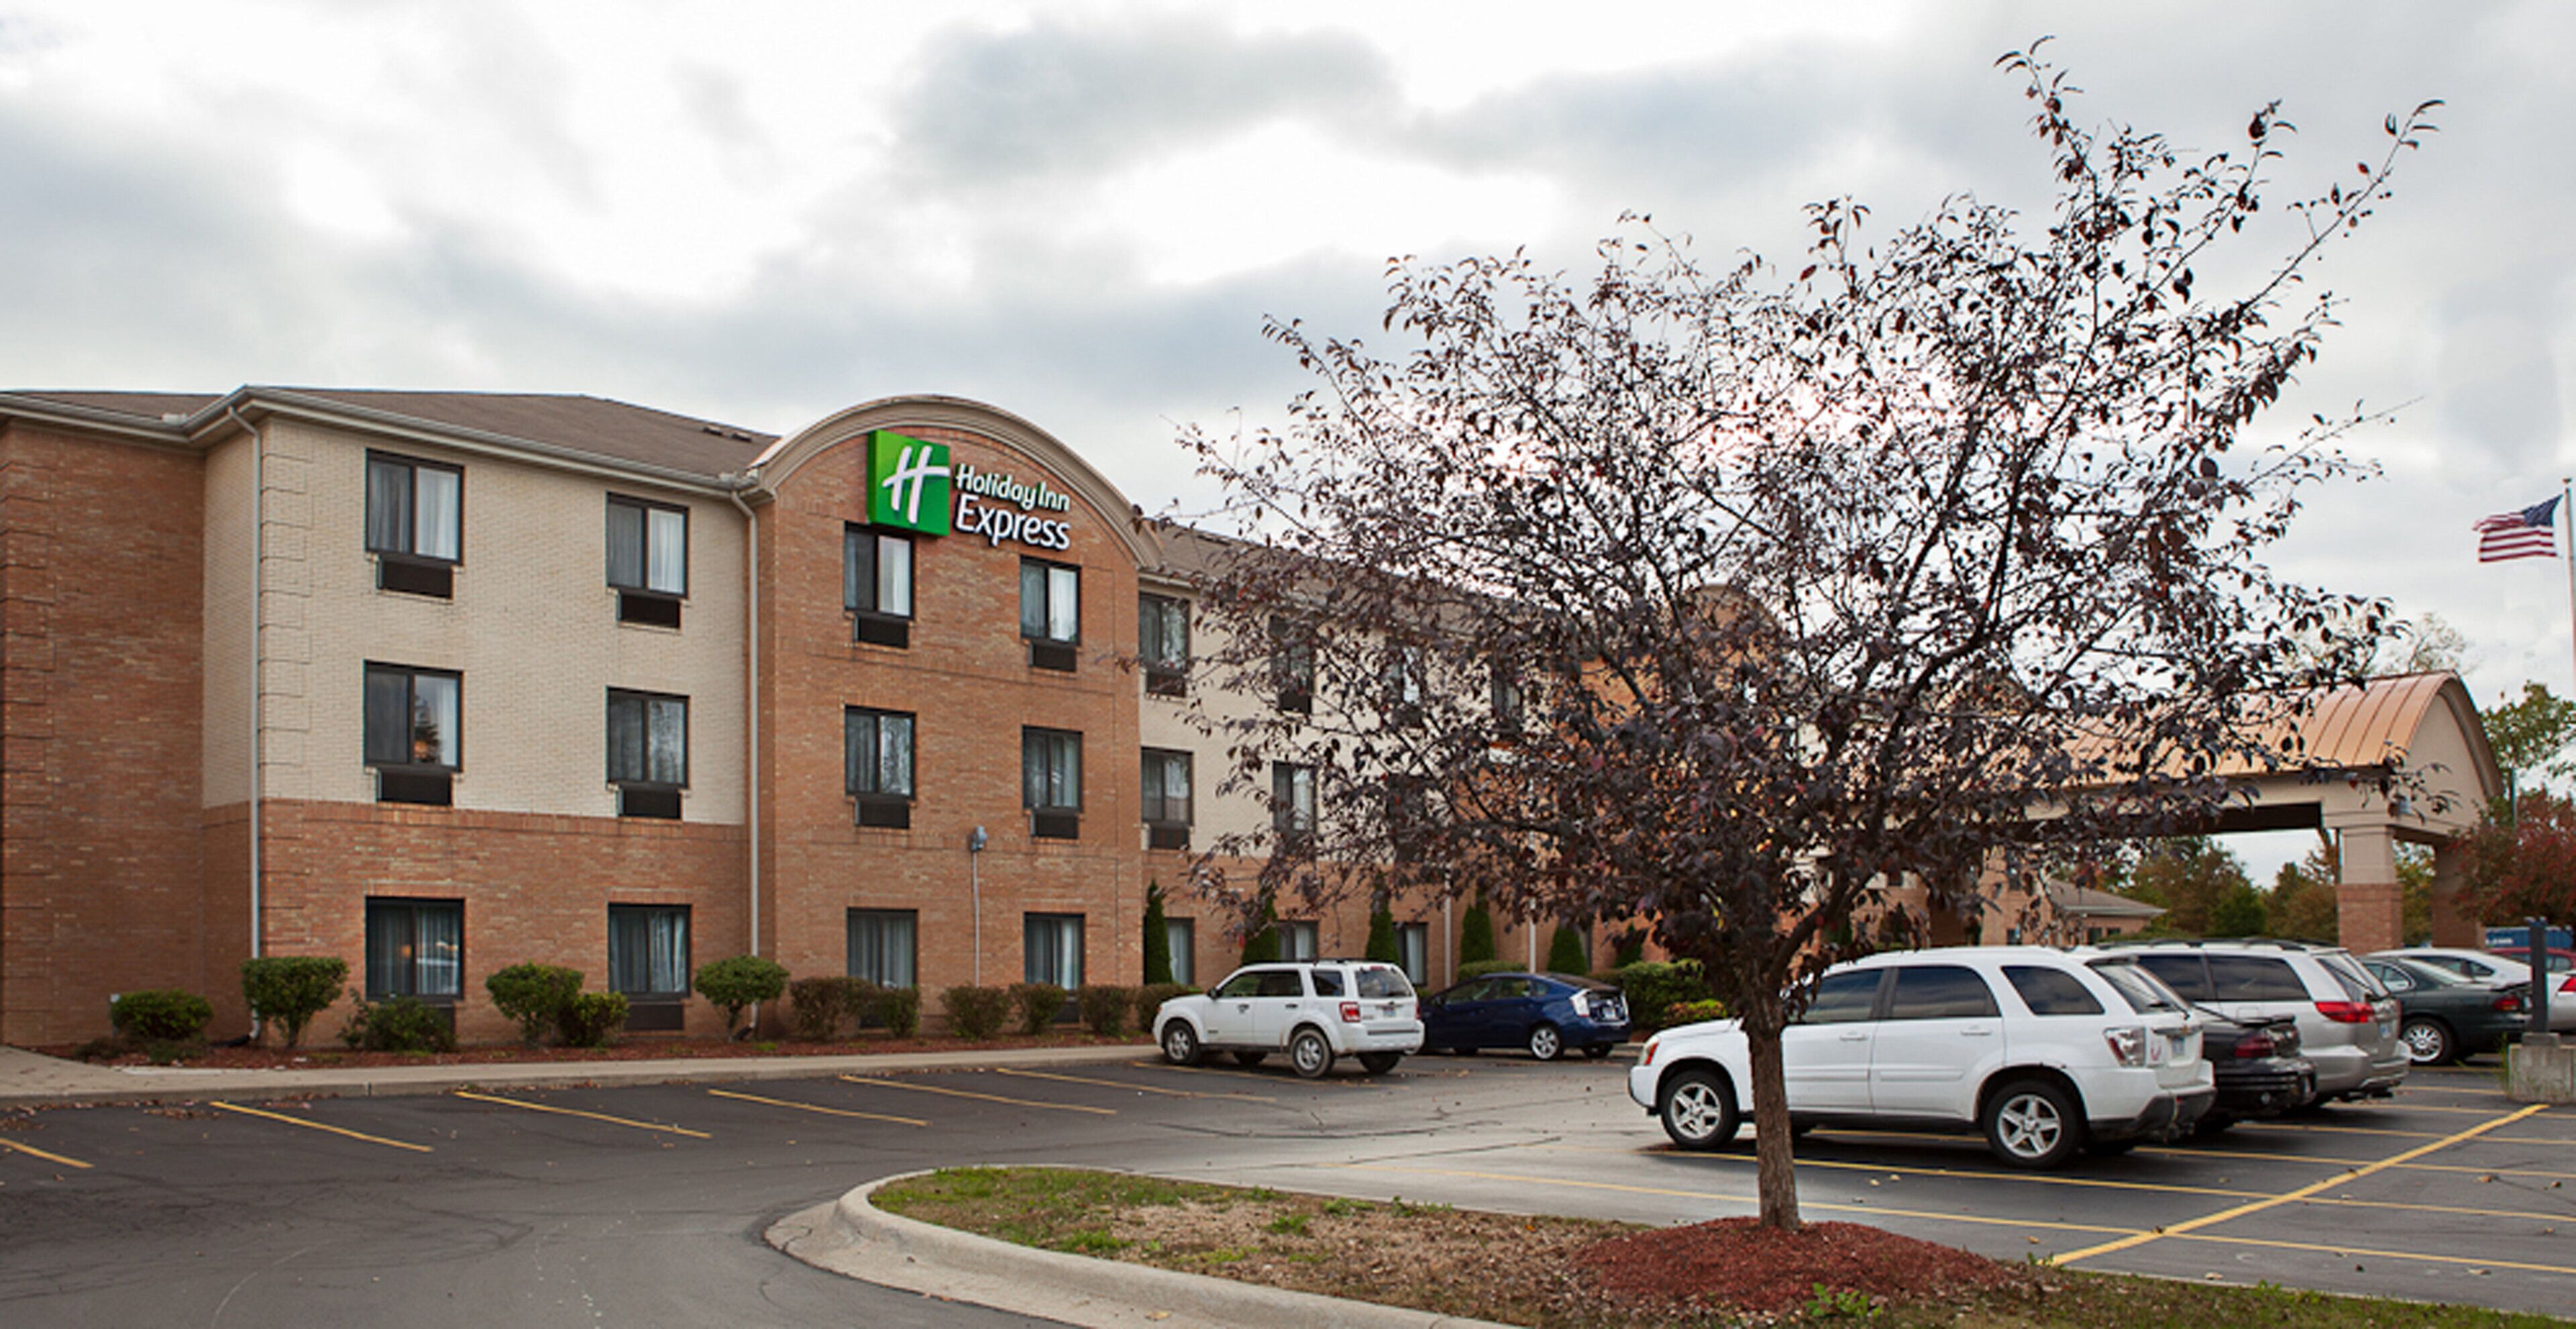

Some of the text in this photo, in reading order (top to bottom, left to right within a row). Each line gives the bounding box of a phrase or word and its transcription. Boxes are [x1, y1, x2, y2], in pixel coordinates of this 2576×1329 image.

[956, 463, 1070, 511] Holiday Inn
[956, 493, 1071, 549] Express
